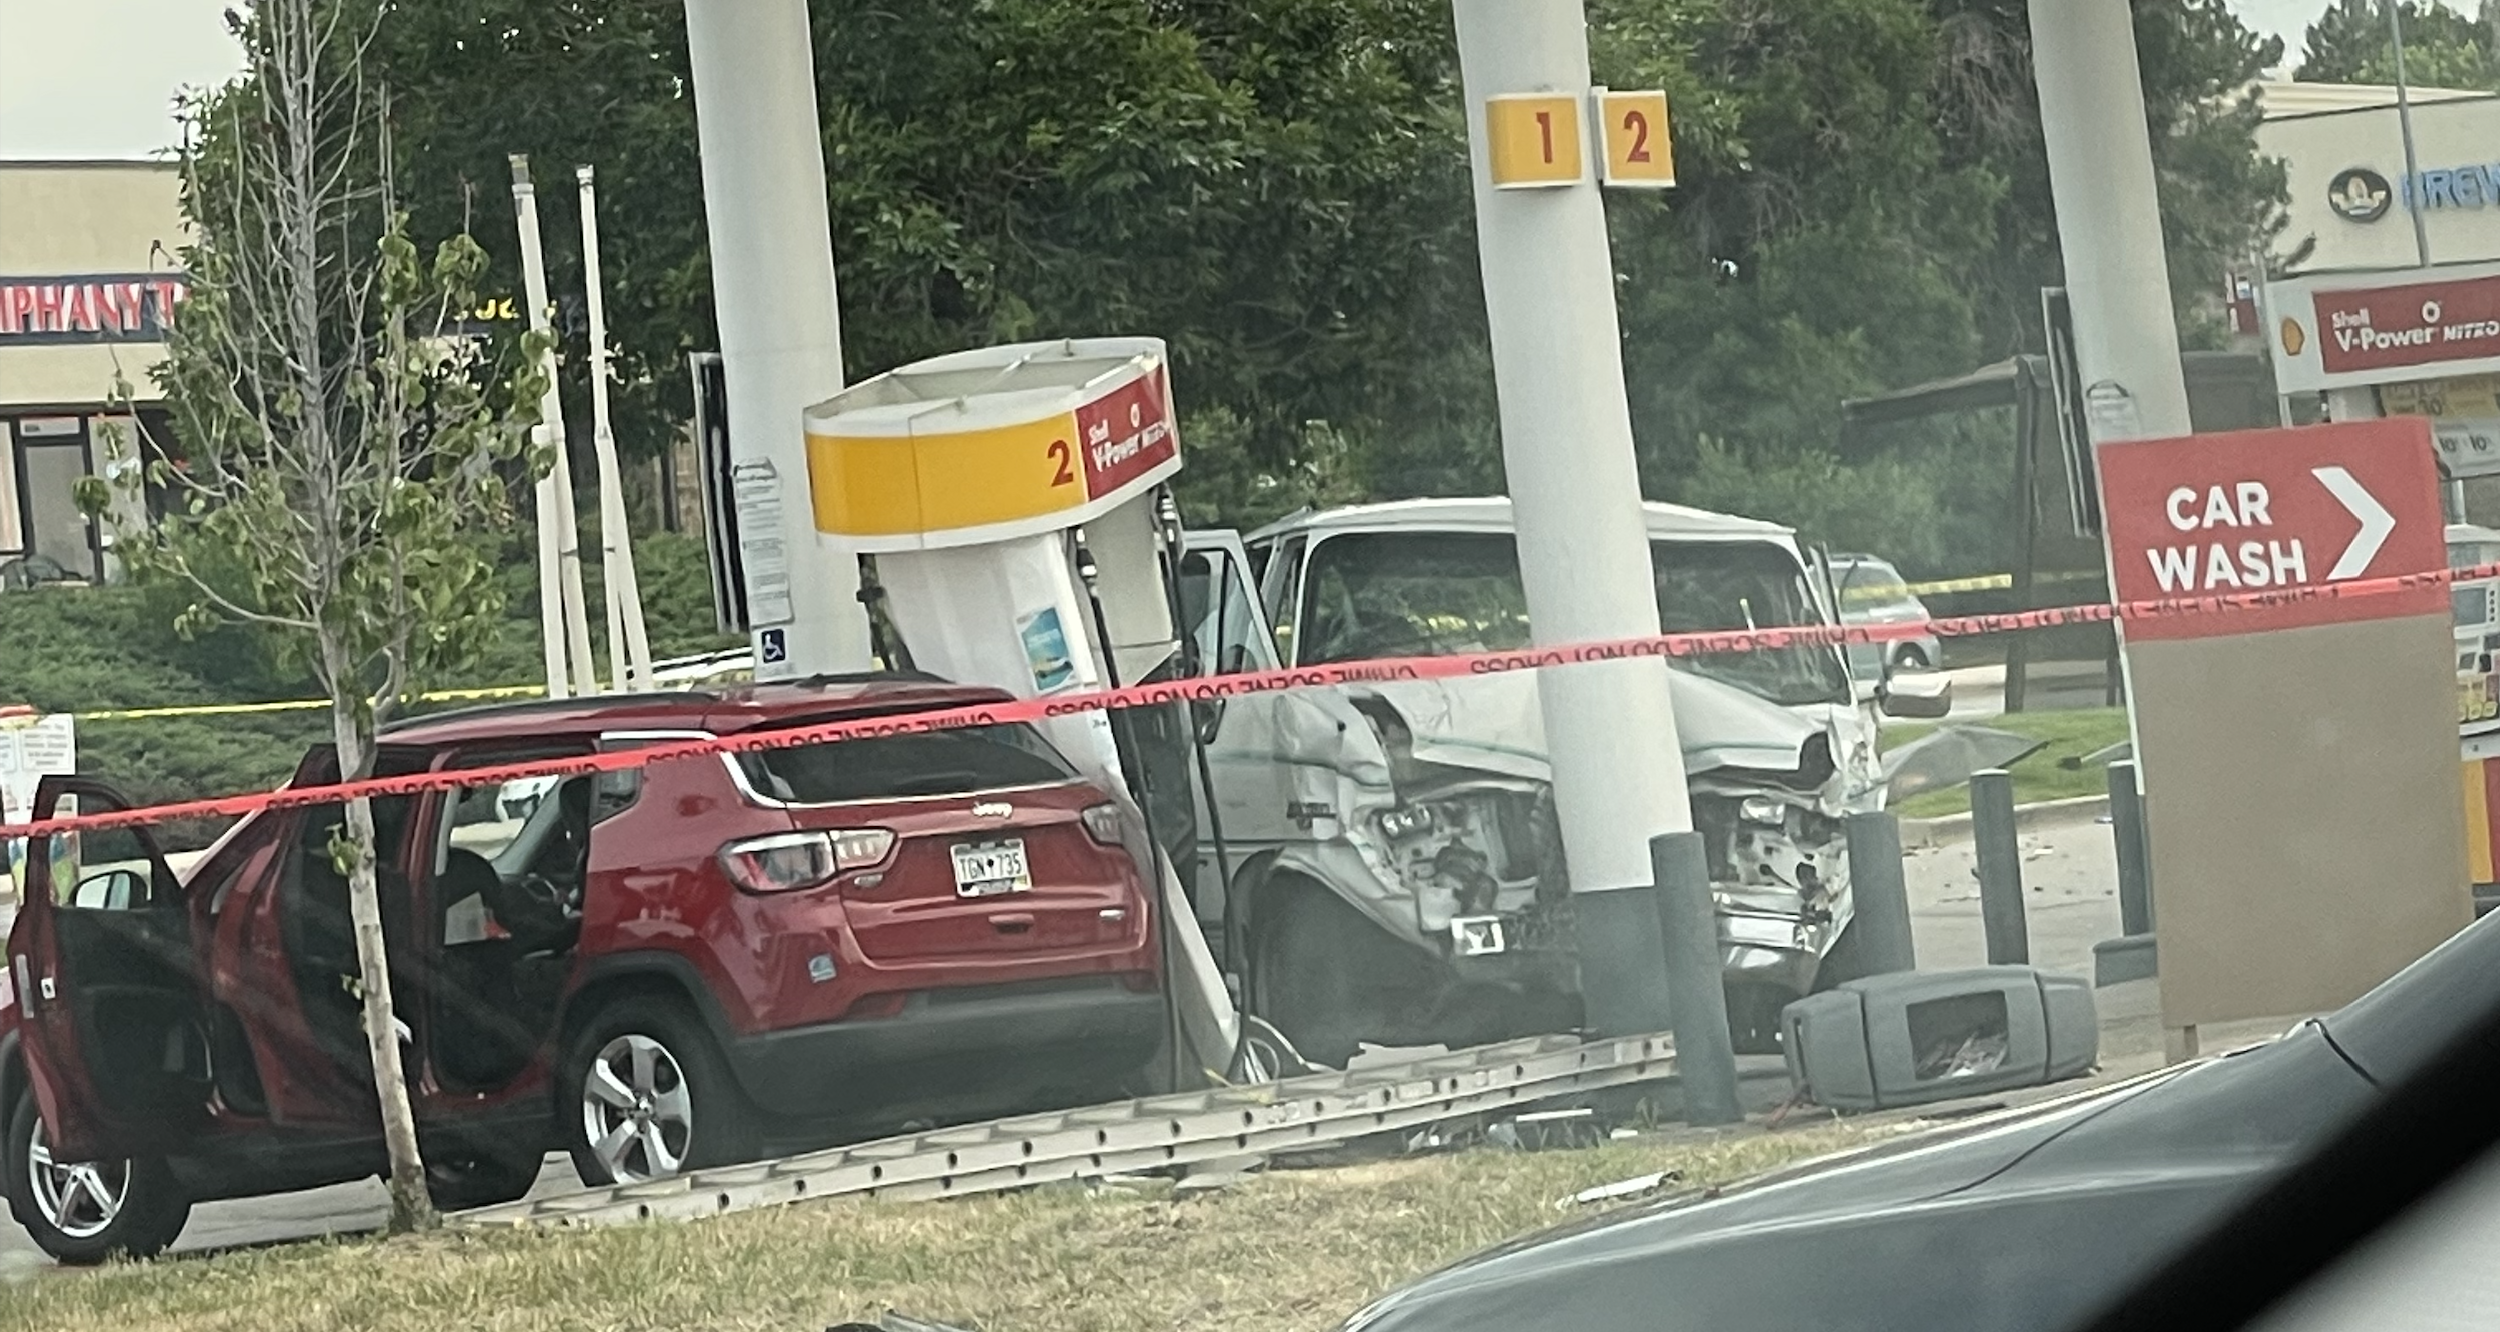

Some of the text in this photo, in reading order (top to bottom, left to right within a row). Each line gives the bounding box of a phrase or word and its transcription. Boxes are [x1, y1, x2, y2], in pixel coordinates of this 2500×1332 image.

[1536, 112, 1553, 163] 1
[1623, 110, 1650, 162] 2
[2331, 307, 2371, 329] Shell
[2334, 326, 2435, 352] V-Power
[1046, 439, 1074, 488] 2
[2166, 481, 2273, 531] CAR
[2146, 538, 2308, 592] WASH
